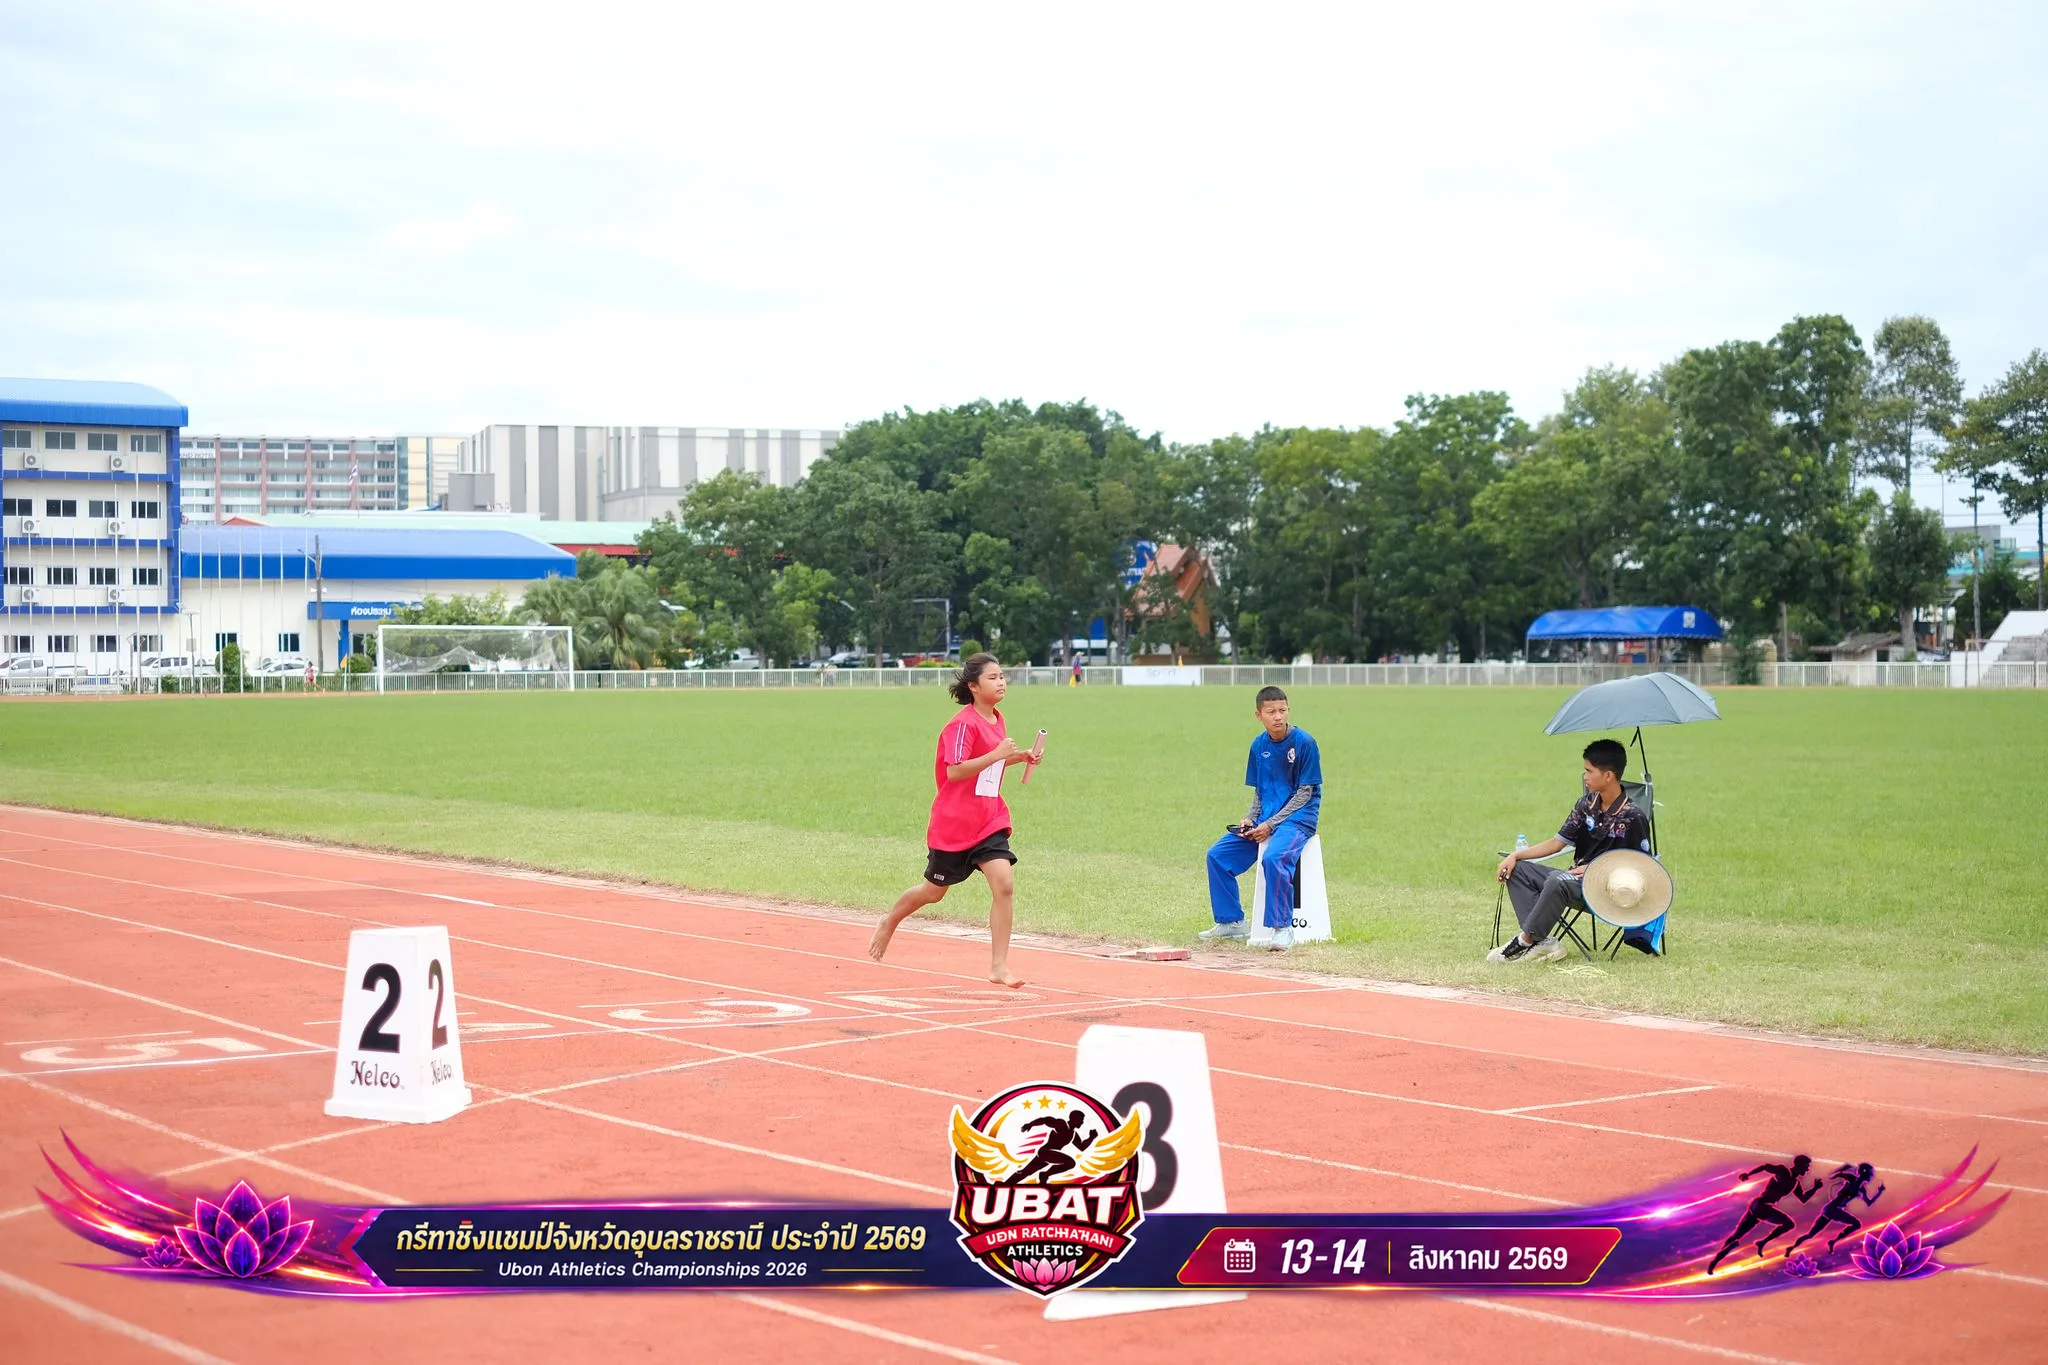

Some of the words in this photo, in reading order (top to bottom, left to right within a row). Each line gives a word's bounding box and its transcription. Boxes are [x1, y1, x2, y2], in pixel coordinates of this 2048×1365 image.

[358, 963, 402, 1053] 2
[428, 959, 448, 1050] 2
[350, 1060, 401, 1088] Nelco
[431, 1059, 452, 1085] Nelco
